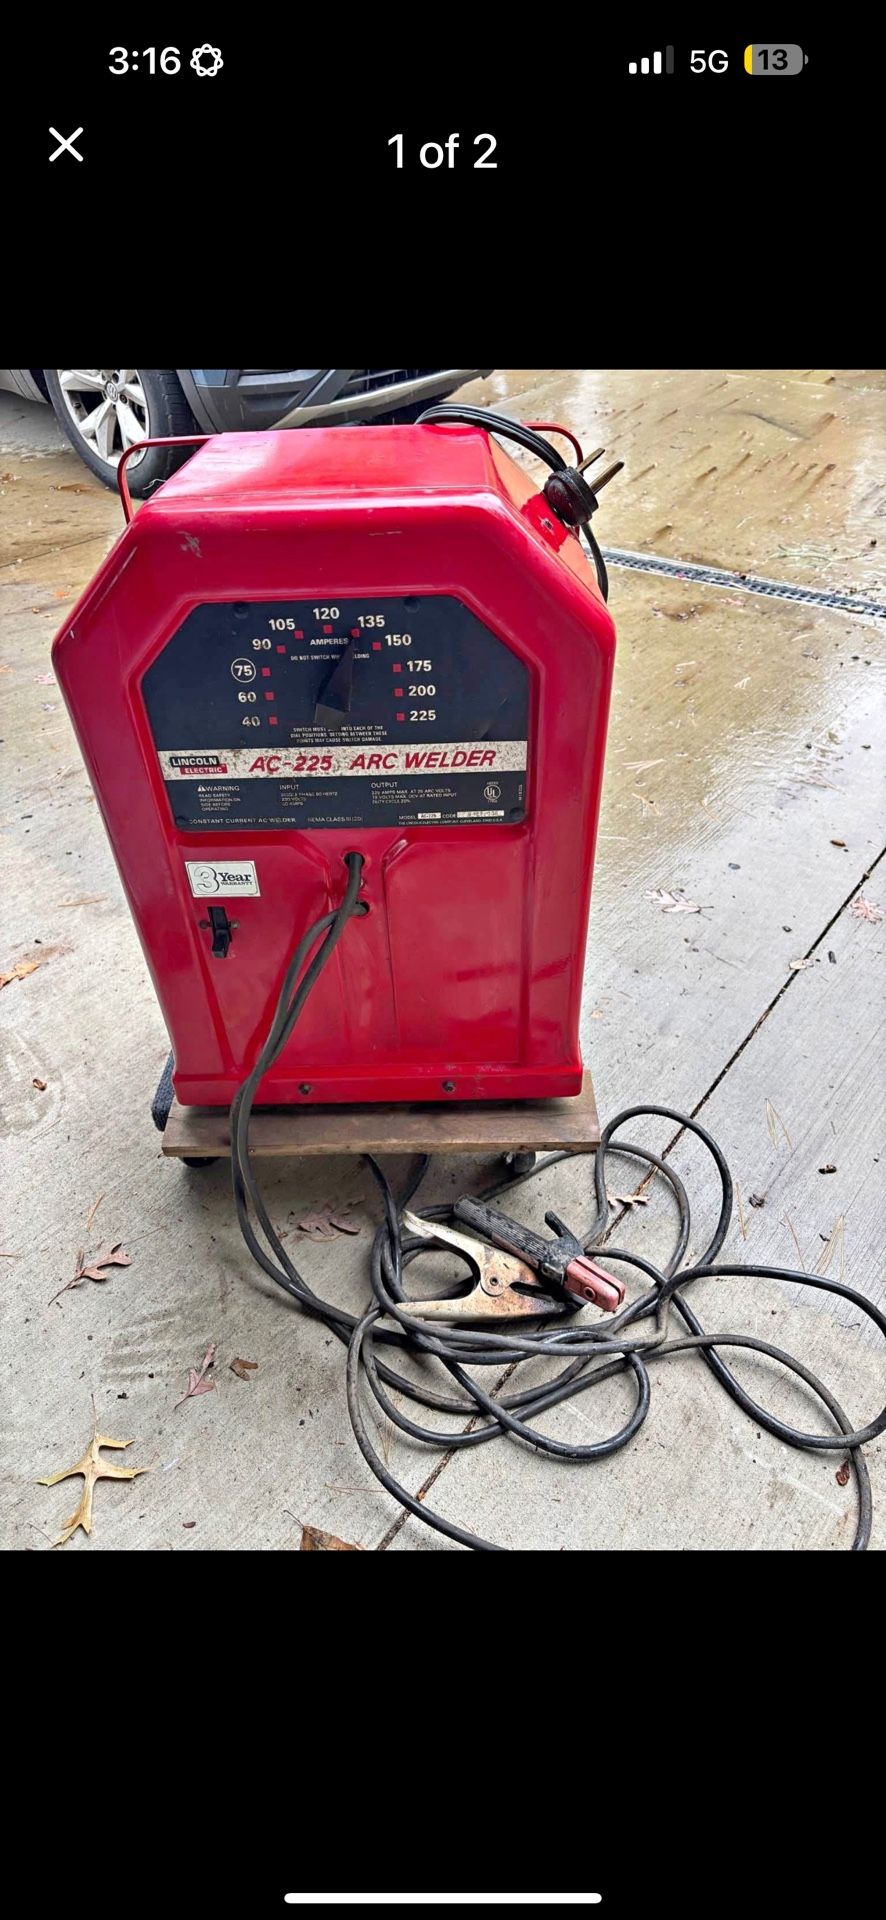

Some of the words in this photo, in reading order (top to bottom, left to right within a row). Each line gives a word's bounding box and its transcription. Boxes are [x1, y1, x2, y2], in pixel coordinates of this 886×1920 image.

[312, 607, 340, 620] 120
[268, 618, 296, 631] 105
[357, 615, 385, 628] 135
[252, 638, 272, 650] 90
[310, 638, 349, 646] AMPERES
[385, 634, 412, 646] 150
[234, 664, 253, 677] 75
[406, 660, 432, 672] 175
[238, 691, 257, 703] 60
[408, 685, 436, 697] 200
[242, 716, 261, 727] 40
[409, 710, 437, 721] 225
[172, 756, 218, 767] LINCOLN
[248, 755, 333, 773] AC-225
[349, 752, 399, 770] ARC
[405, 749, 497, 769] WELDER
[184, 765, 223, 774] ELECTRIC
[371, 781, 398, 789] OUTPUT
[194, 865, 220, 893] 3
[218, 872, 252, 882] Year
